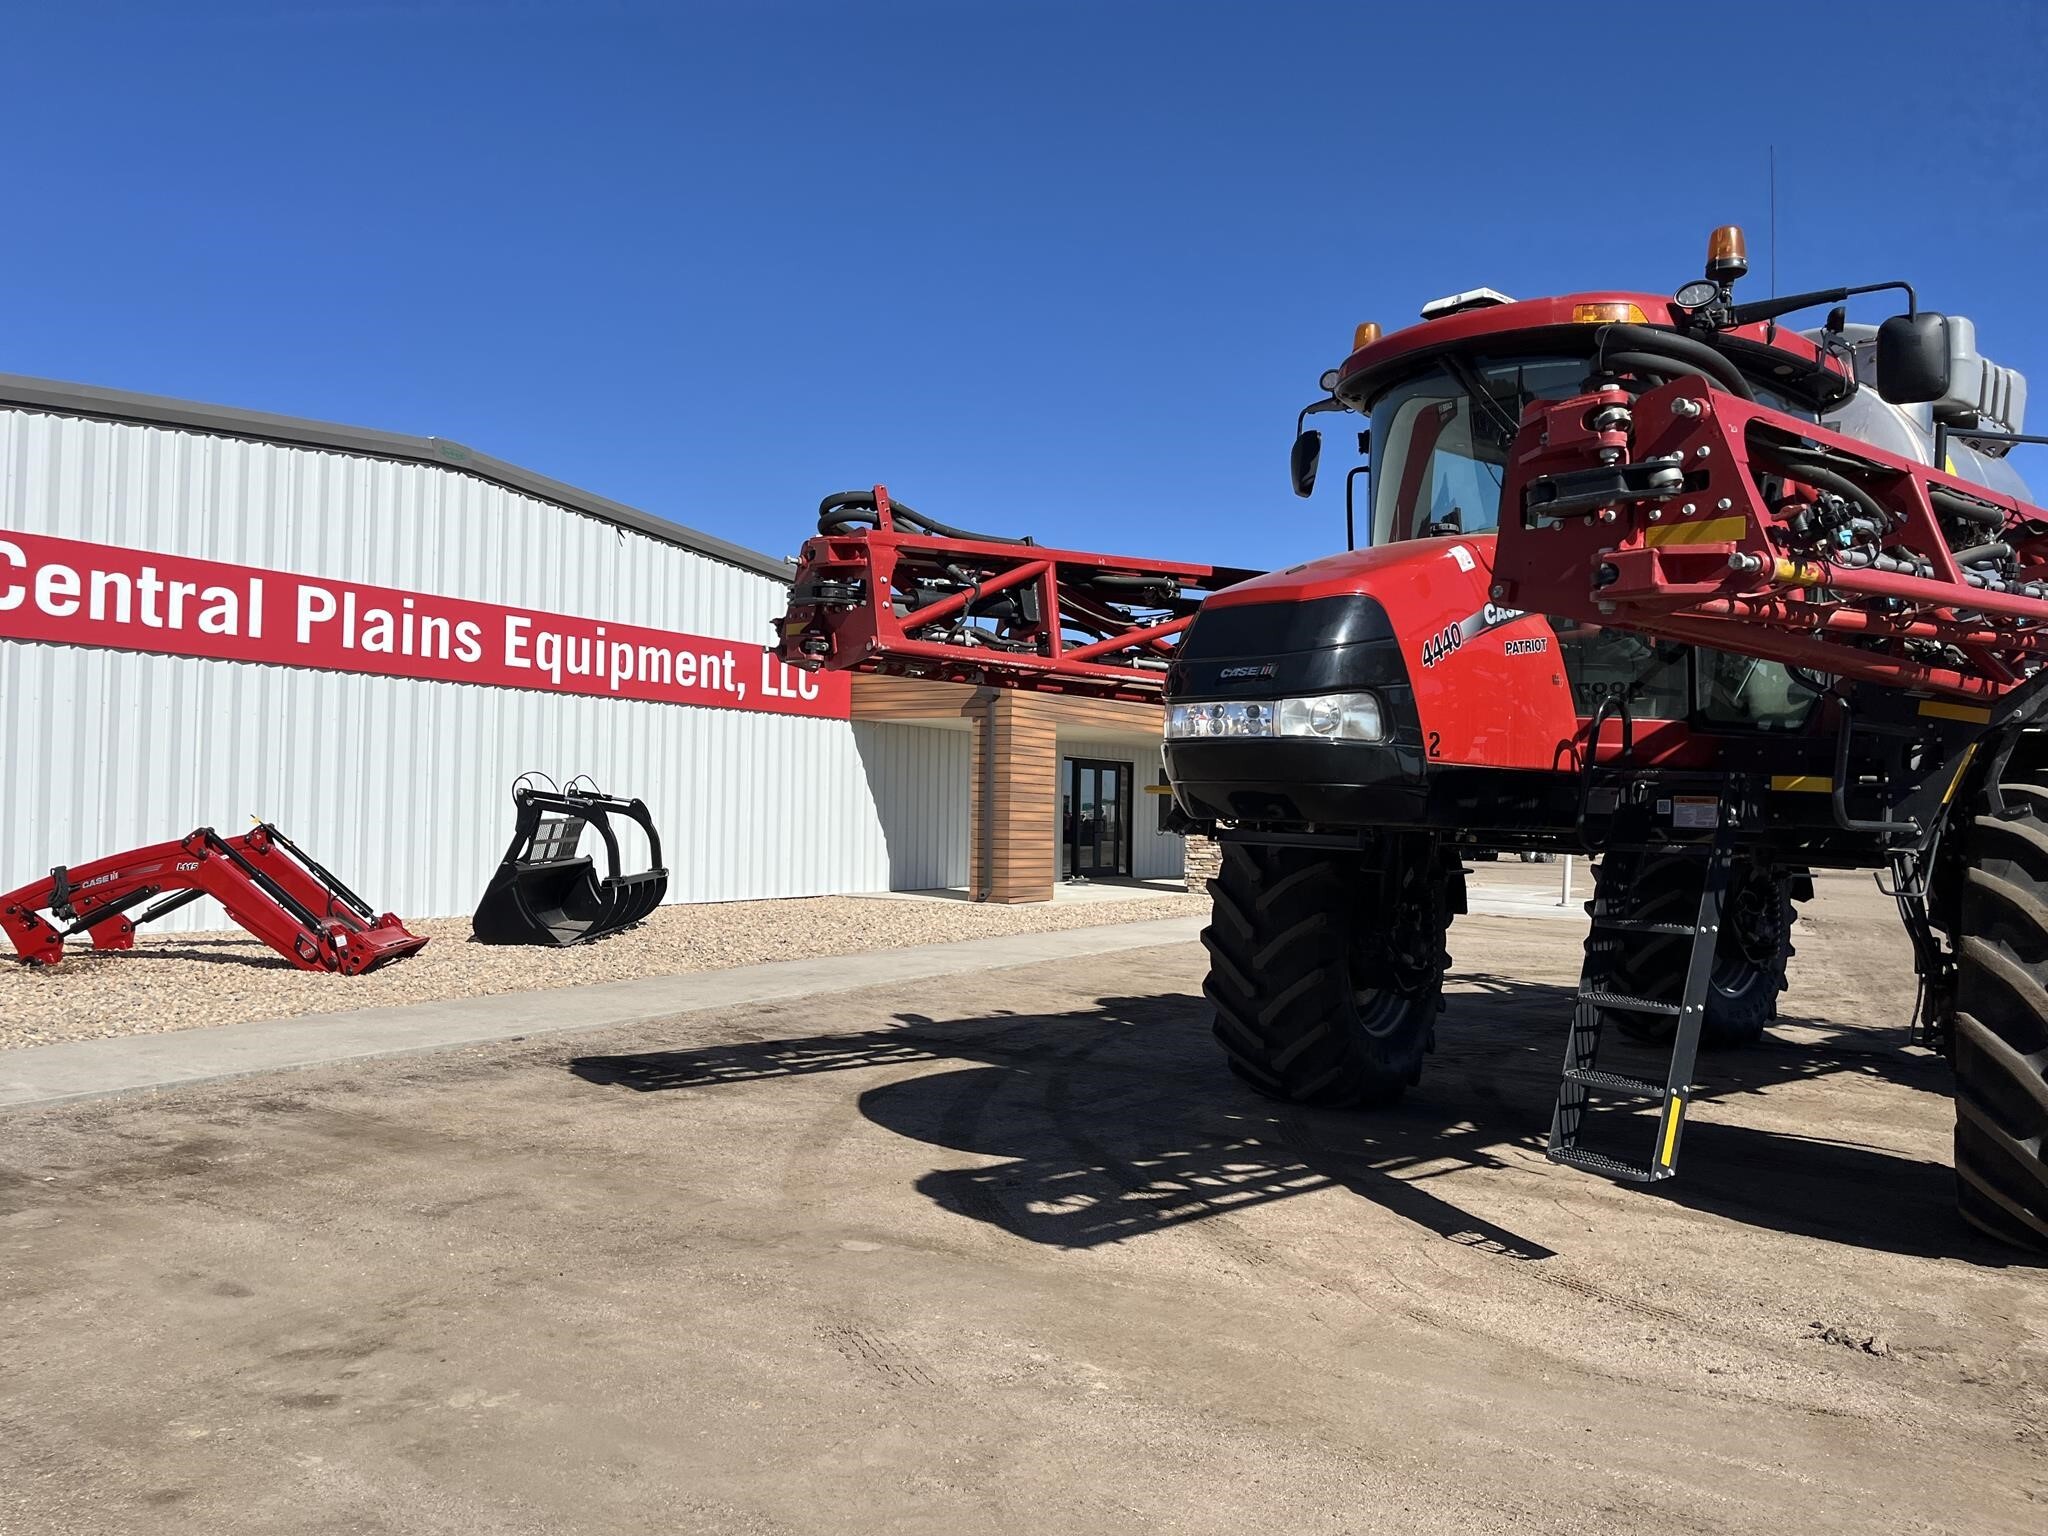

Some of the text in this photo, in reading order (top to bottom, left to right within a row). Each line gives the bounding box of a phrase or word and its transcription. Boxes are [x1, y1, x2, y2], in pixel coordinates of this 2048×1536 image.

[296, 584, 482, 663] Plains
[504, 614, 746, 701] Equipment,
[761, 652, 819, 701] LLC
[1422, 622, 1462, 668] 4440
[1505, 637, 1548, 656] PATRIOT
[1220, 666, 1260, 679] CASE
[1428, 731, 1441, 758] 2
[82, 874, 110, 889] CASE
